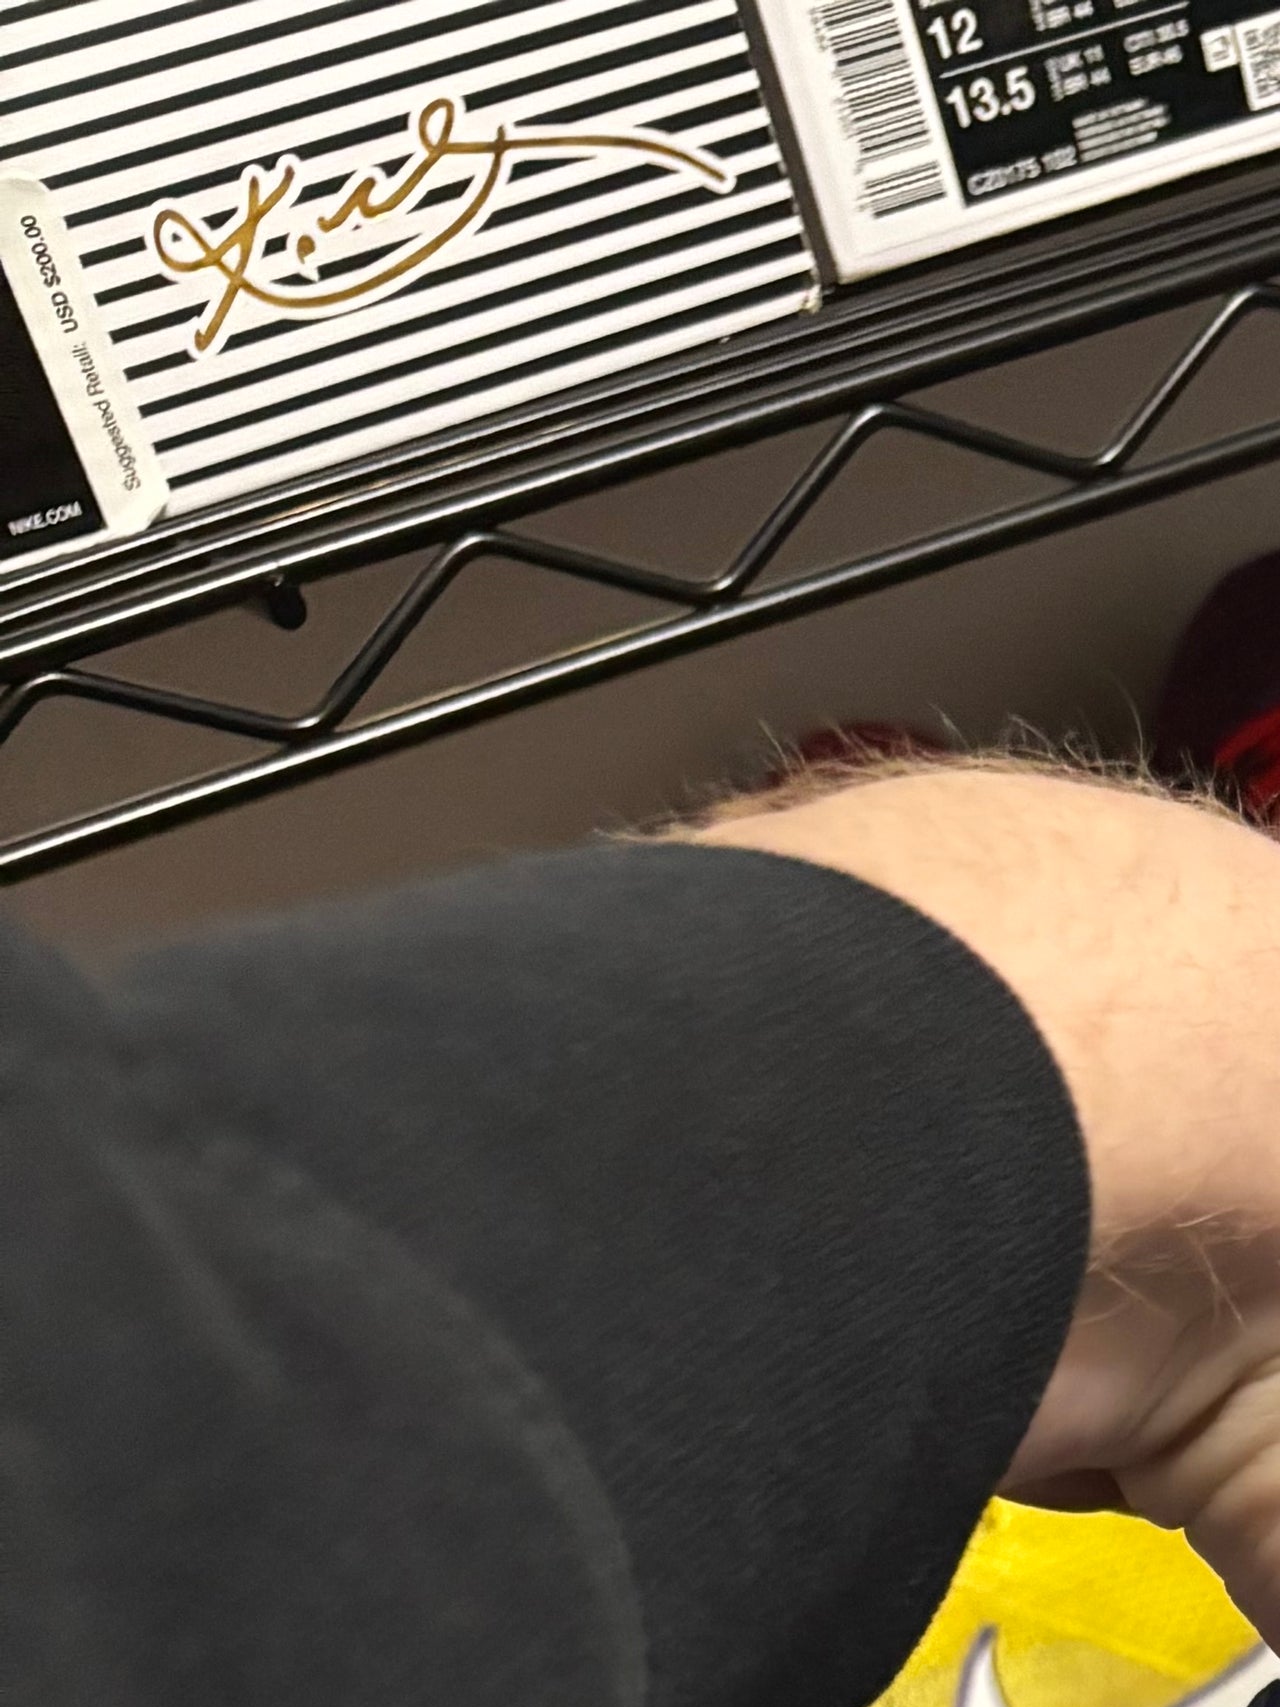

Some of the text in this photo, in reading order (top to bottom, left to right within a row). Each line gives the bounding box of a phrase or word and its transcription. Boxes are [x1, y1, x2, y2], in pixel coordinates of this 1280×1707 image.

[926, 7, 984, 60] 12
[946, 65, 1037, 129] 13.5
[20, 214, 141, 492] Suggested Retail: USD $200.00
[7, 500, 83, 537] NIKE.COM
